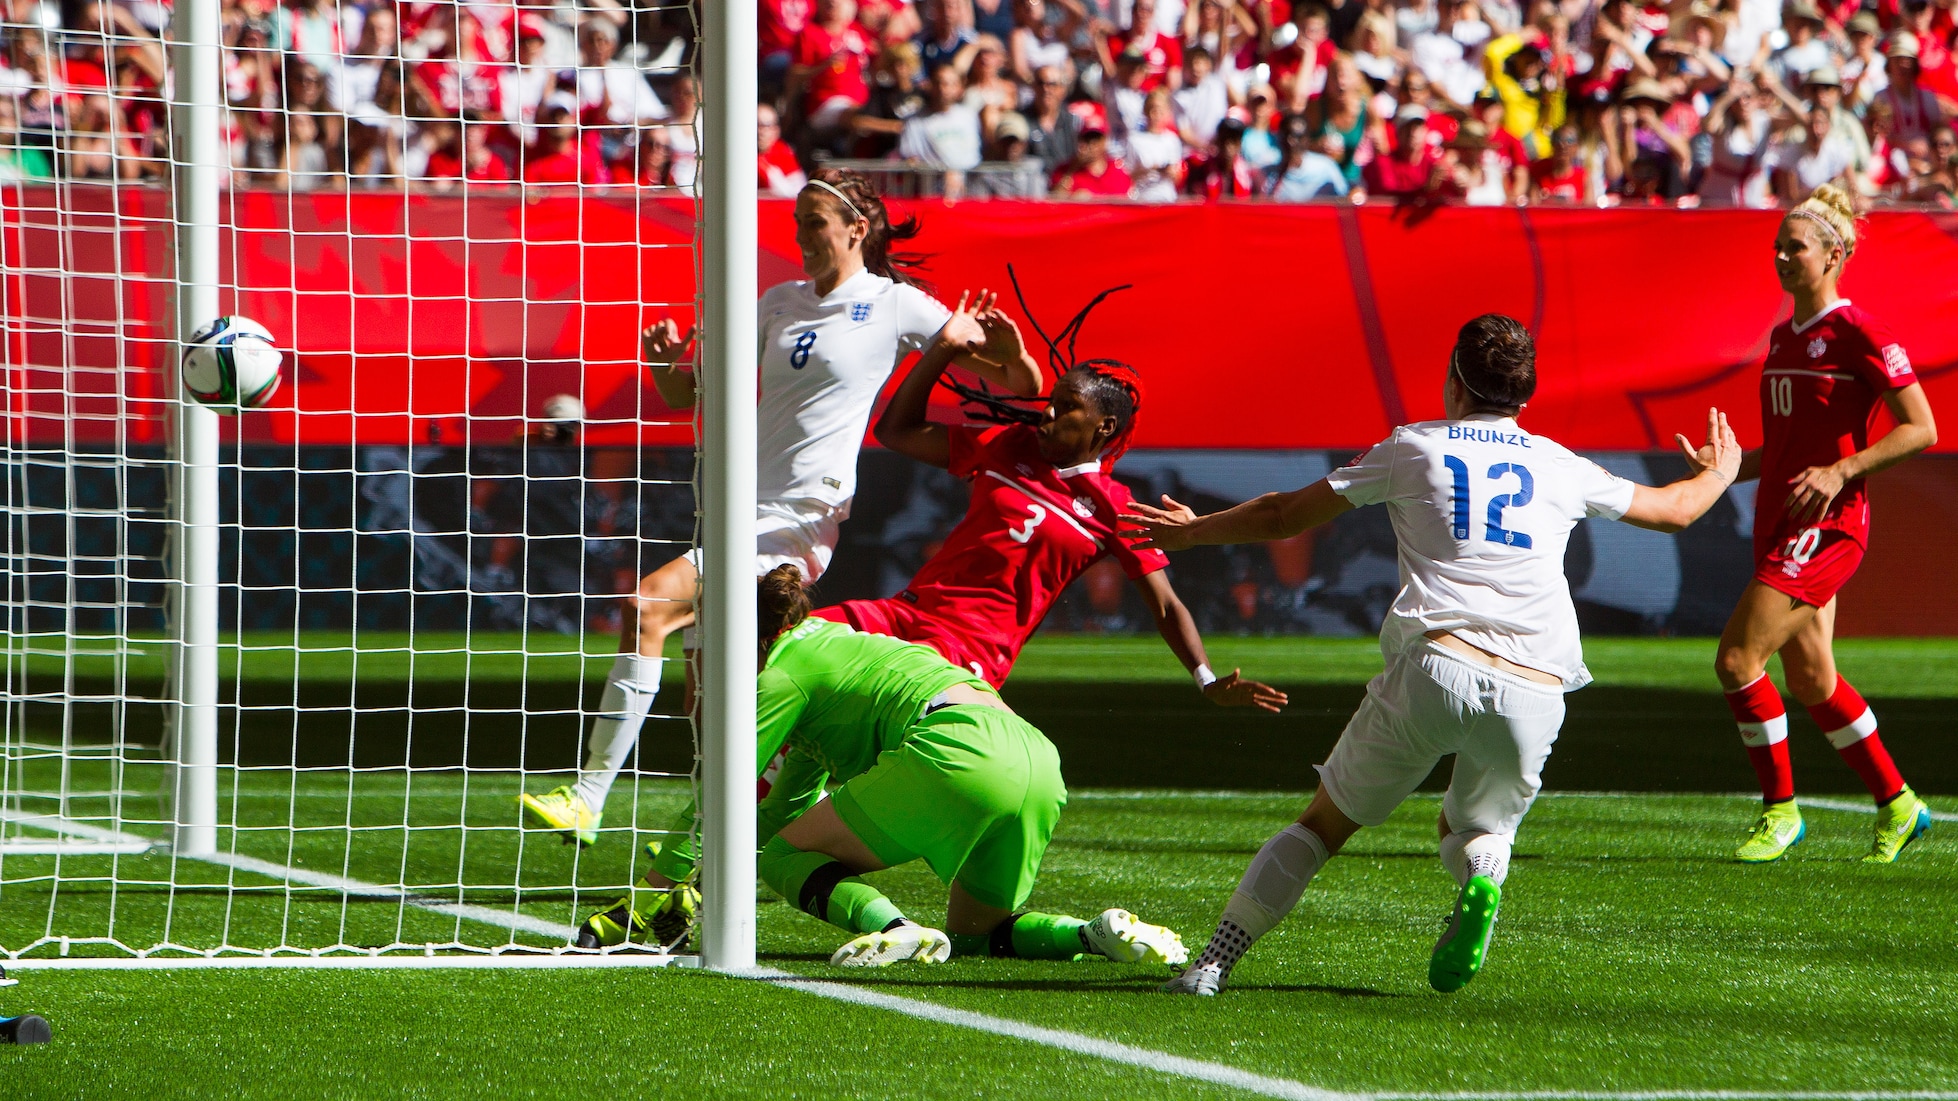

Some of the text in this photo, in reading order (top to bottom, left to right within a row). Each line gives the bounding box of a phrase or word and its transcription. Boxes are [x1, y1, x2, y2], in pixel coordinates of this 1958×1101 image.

[790, 330, 817, 370] 8
[1770, 376, 1792, 417] 10
[1444, 454, 1534, 550] 12
[1009, 503, 1047, 544] 3
